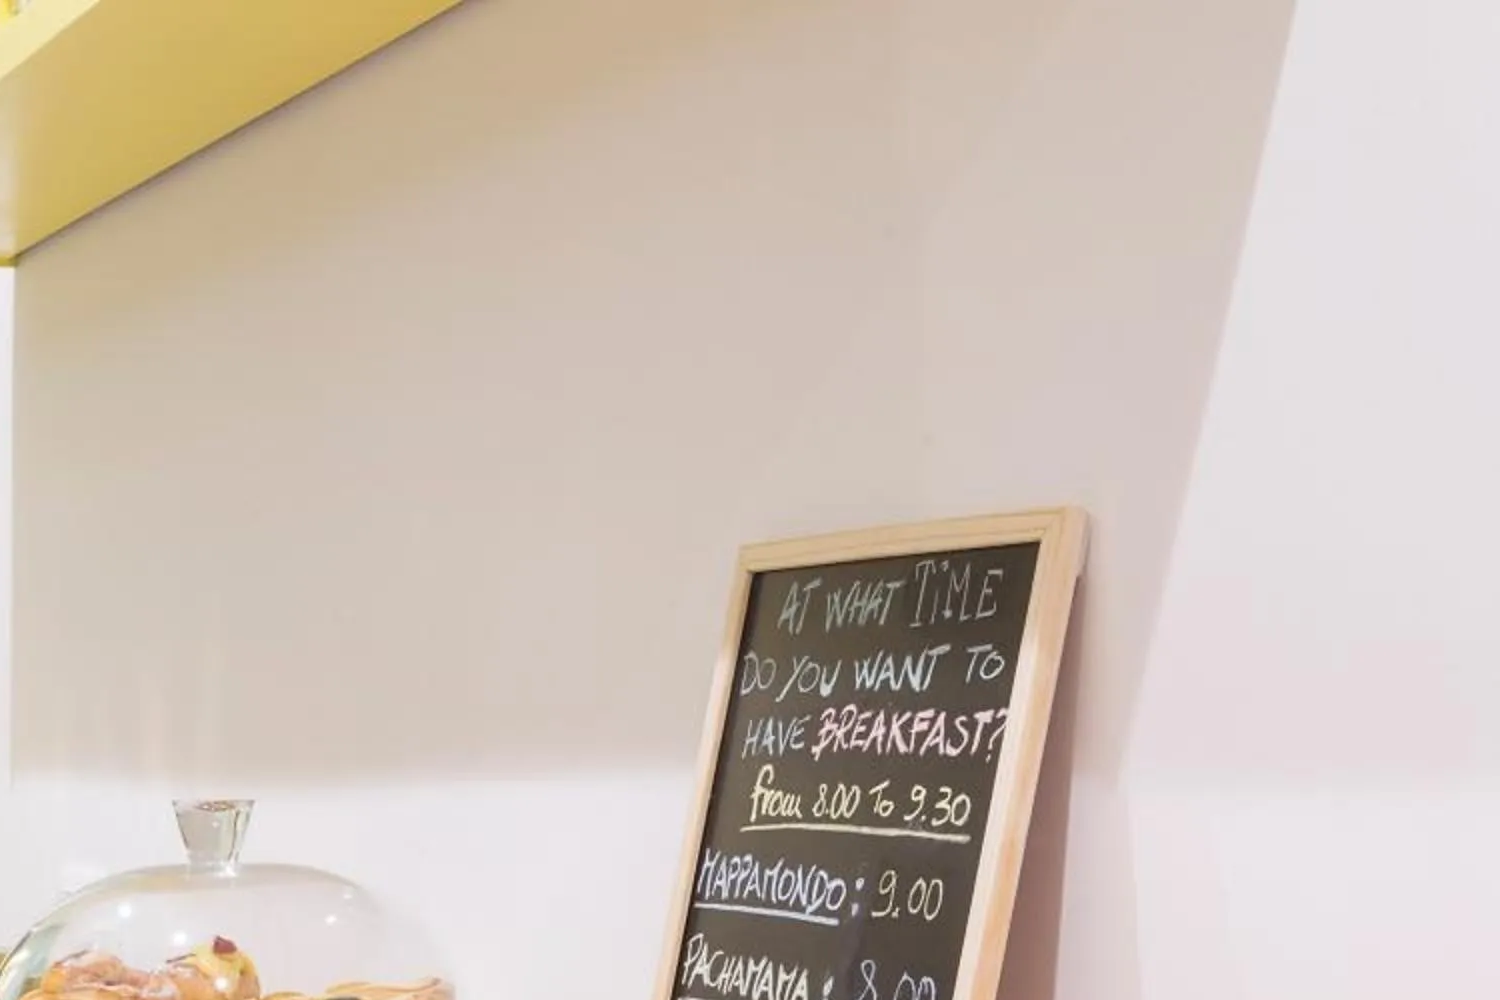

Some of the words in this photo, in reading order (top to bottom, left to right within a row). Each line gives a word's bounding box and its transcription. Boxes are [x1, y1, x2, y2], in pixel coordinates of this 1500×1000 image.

[777, 577, 824, 636] AT
[825, 578, 906, 634] WHAT
[740, 651, 778, 697] DO
[775, 655, 843, 702] YOU
[854, 644, 952, 692] WANT
[965, 644, 1007, 685] TO
[741, 715, 812, 760] HAVE
[811, 703, 1011, 763] BREAKFAST?
[750, 763, 803, 823] from
[812, 783, 862, 820] 8.00
[904, 785, 972, 828] 9.30
[871, 869, 943, 921] 9.00
